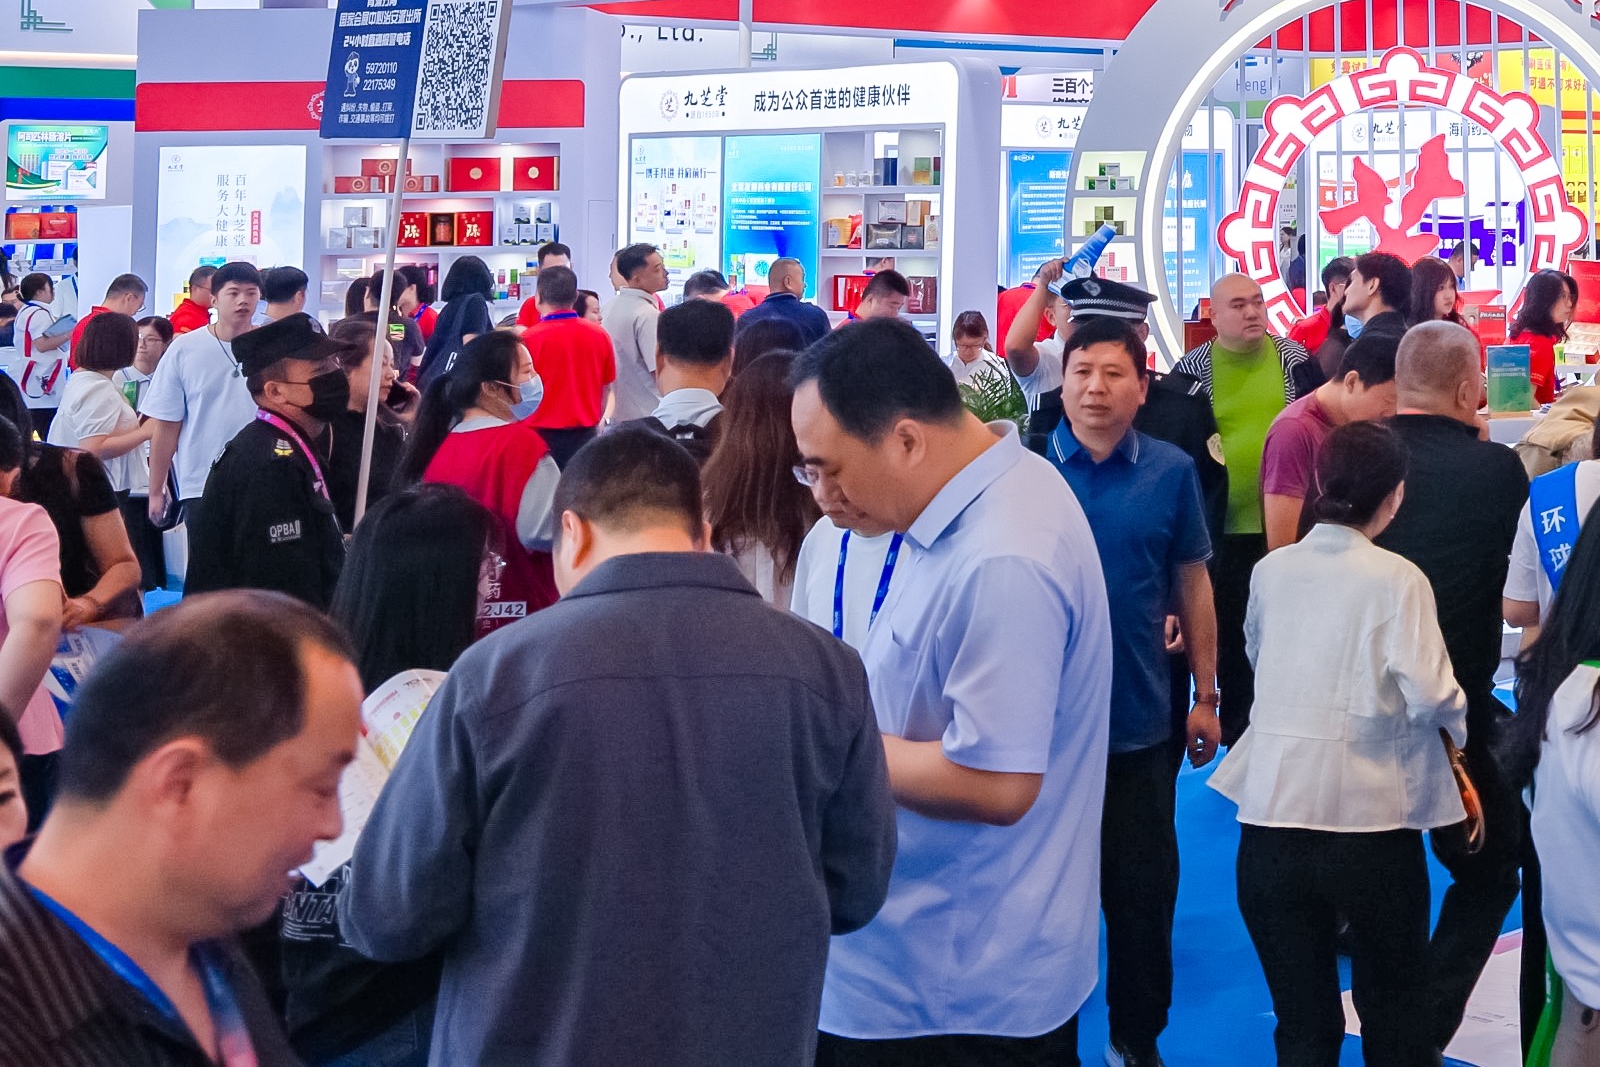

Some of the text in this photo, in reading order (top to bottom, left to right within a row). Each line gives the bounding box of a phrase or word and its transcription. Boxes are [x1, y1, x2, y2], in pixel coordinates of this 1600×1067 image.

[365, 62, 398, 74] 59720110
[362, 78, 396, 91] 22175349
[1052, 77, 1093, 94] 三百个
[683, 84, 728, 107] 九芝堂
[753, 83, 911, 112] 成为公众首选的健康伙伴
[215, 174, 230, 247] 服务大健康
[233, 173, 247, 247] 百年九芝堂
[483, 603, 524, 617] 2J42
